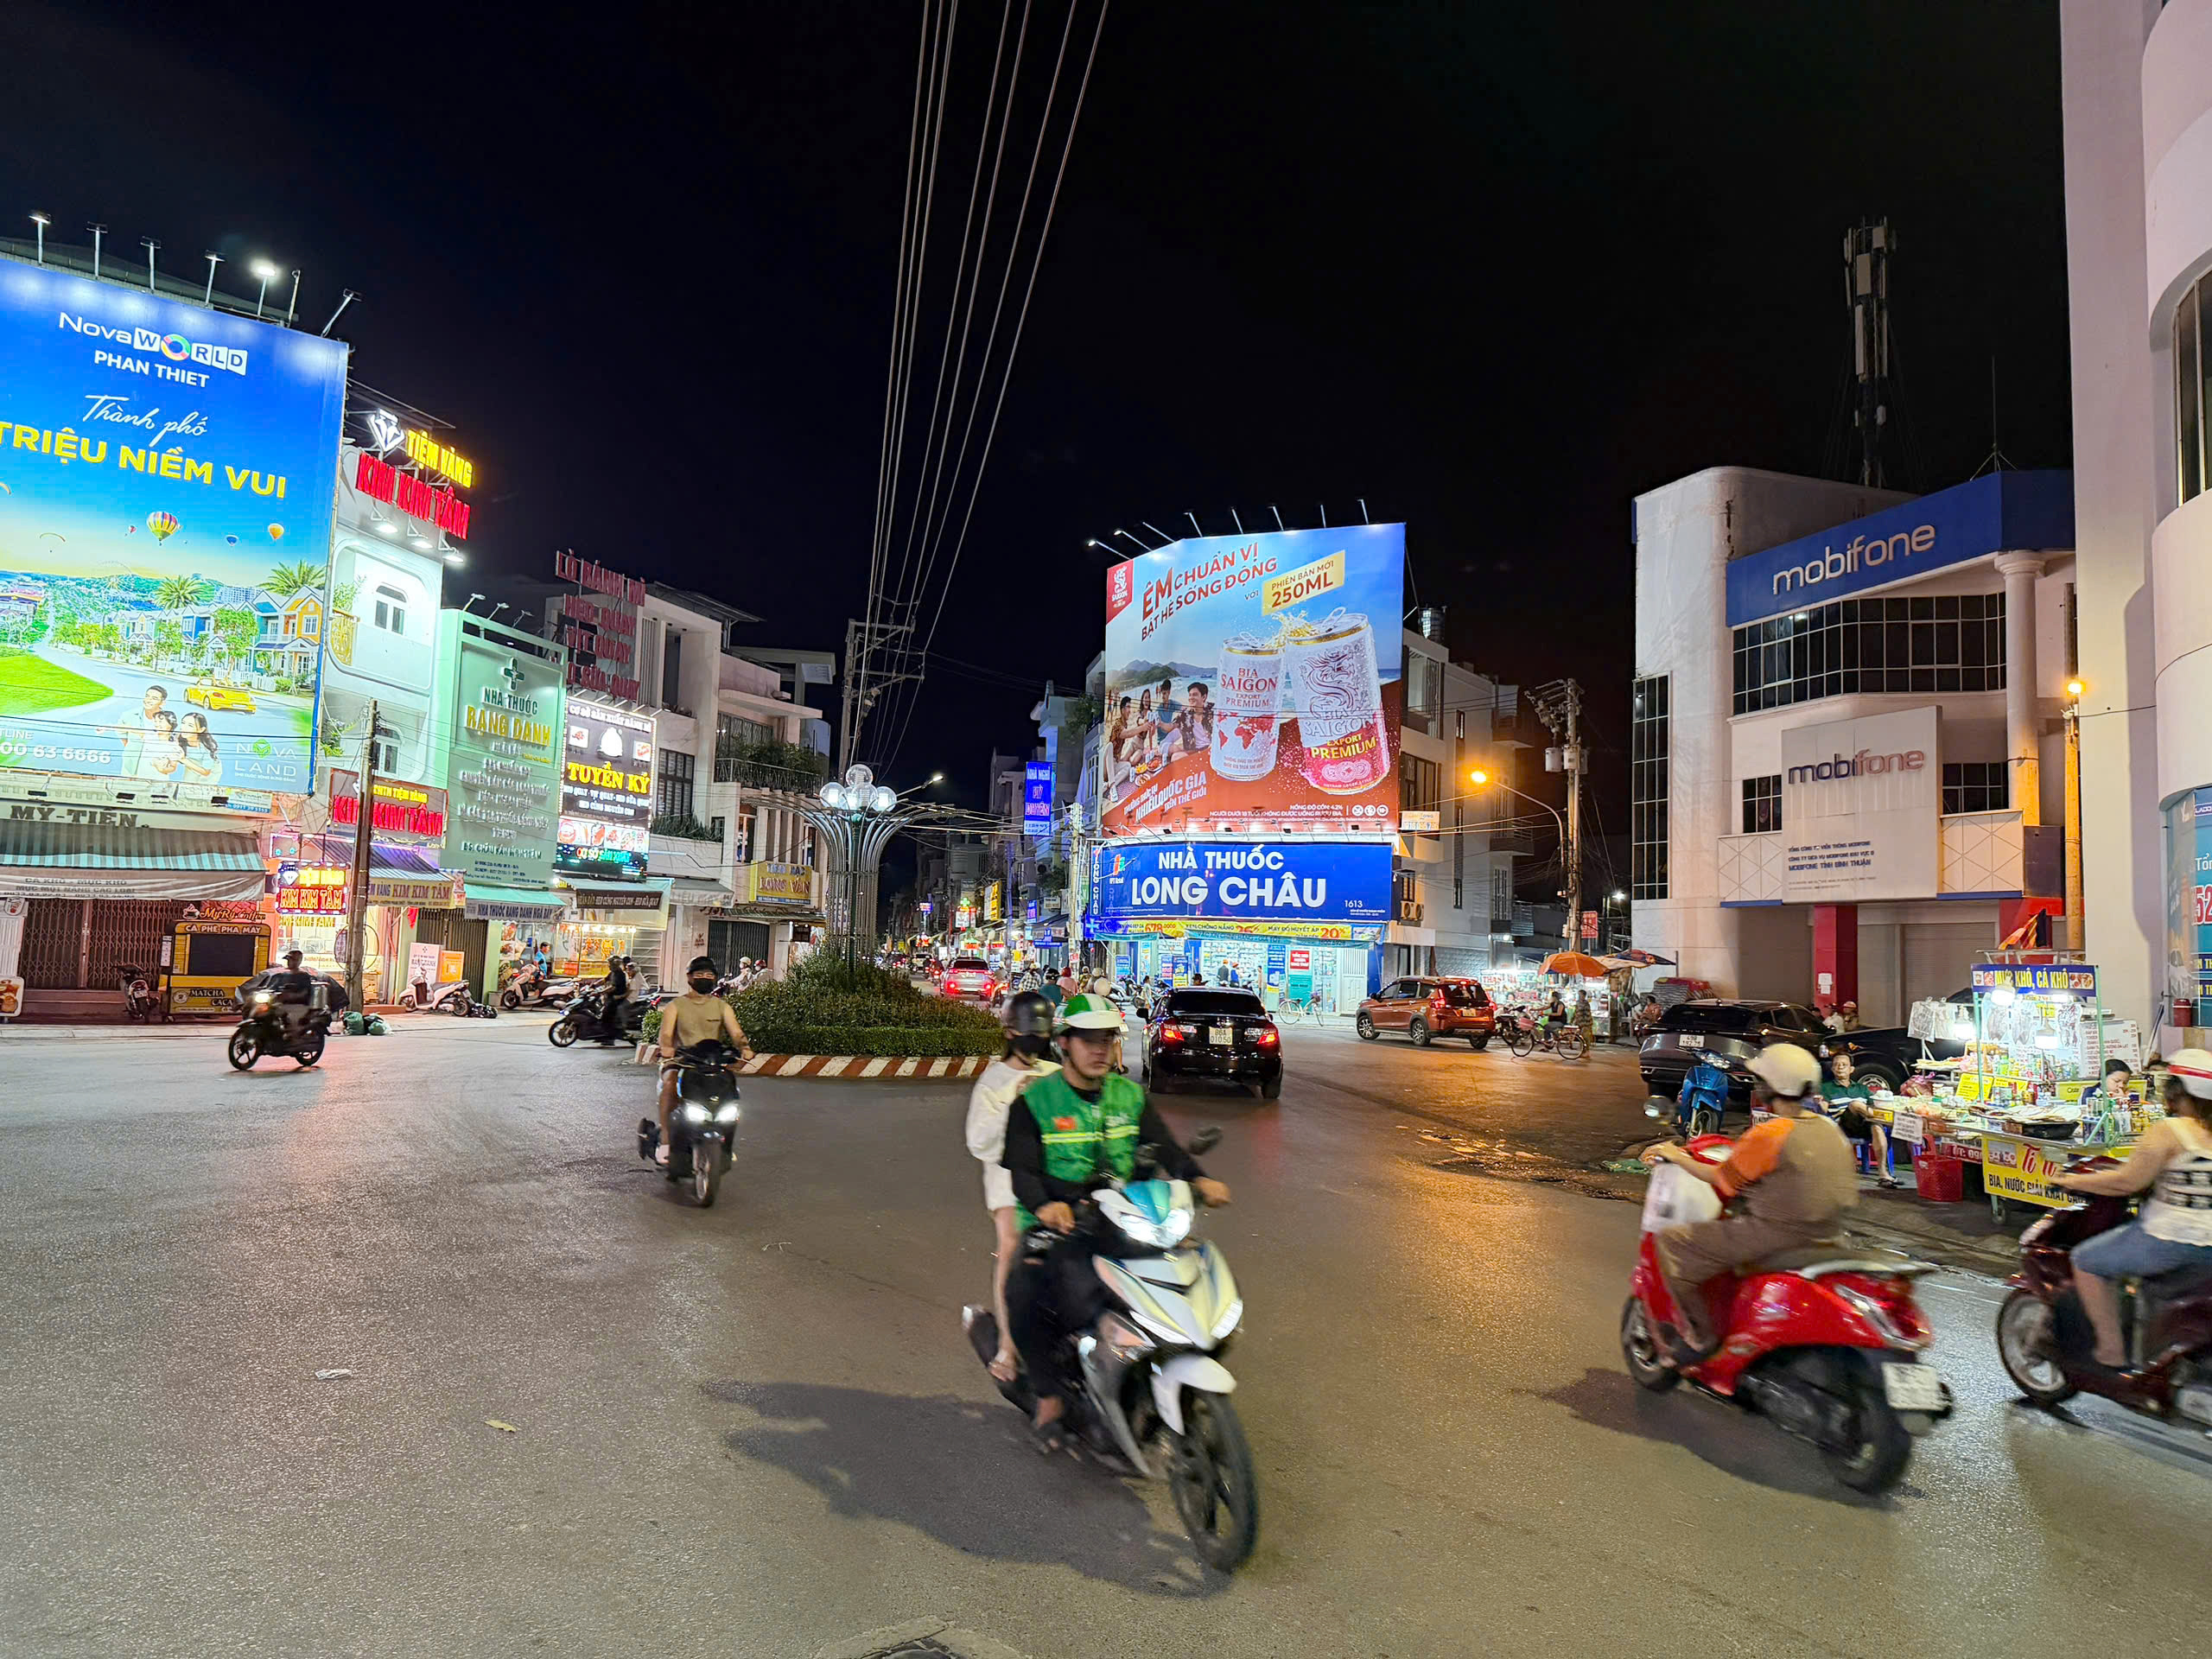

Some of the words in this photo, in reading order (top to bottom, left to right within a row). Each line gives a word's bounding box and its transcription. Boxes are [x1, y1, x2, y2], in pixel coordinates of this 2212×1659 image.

[94, 350, 149, 375] PHAN
[155, 364, 210, 388] THIET
[83, 395, 156, 429] Thành
[149, 414, 207, 448] phố
[0, 421, 107, 464] TRIỆU
[119, 446, 213, 485] NIỀM
[226, 465, 287, 499] VUI
[407, 429, 439, 470] TIỆM
[441, 446, 473, 489] VÀNG
[357, 453, 396, 505] KIM
[397, 472, 433, 522] KIM
[435, 486, 471, 540] TÂM
[1773, 524, 1936, 594] mobifone
[1142, 567, 1173, 621] ÊM
[1174, 550, 1236, 590] CHUẨN
[1240, 542, 1258, 563] VỊ
[1272, 575, 1295, 591] PHIÊN
[1298, 568, 1315, 580] BẢN
[1317, 560, 1334, 573] MỚI
[1141, 614, 1160, 642] BẬT
[1160, 601, 1175, 624] HÈ
[1176, 583, 1223, 611] SỐNG
[1224, 557, 1277, 589] ĐỘNG
[1272, 572, 1333, 608] 250ML
[598, 607, 637, 637] QUAY
[594, 635, 632, 664] QUAY
[1221, 674, 1278, 692] SAIGON
[1238, 668, 1258, 677] BIA
[484, 687, 504, 707] NHÀ
[505, 694, 538, 715] THUỐC
[1226, 697, 1269, 708] PREMIUM
[466, 705, 506, 736] RẠNG
[512, 717, 551, 747] DANH
[1305, 715, 1376, 738] SAIGON
[1327, 733, 1363, 747] EXPORT
[33, 745, 58, 759] 63
[61, 747, 111, 764] 6666
[1310, 736, 1376, 759] PREMIUM
[234, 760, 297, 777] LAND
[1185, 771, 1206, 791] GIA
[1789, 749, 1924, 785] mobifone
[1178, 790, 1192, 805] THẾ
[1192, 785, 1207, 799] GIỚI
[373, 802, 406, 832] KIM
[407, 804, 443, 836] TÂM
[1159, 846, 1198, 869] NHÀ
[1205, 844, 1284, 869] THUỐC
[280, 888, 299, 909] KIM
[320, 885, 342, 910] TÂM
[392, 884, 410, 899] KIM
[411, 885, 429, 899] KIM
[431, 882, 450, 899] TÂM
[1132, 876, 1209, 906] LONG
[1219, 872, 1326, 907] CHÂU
[1344, 899, 1363, 908] 1613
[2036, 968, 2050, 988] CÁ
[2050, 968, 2069, 989] KHÔ
